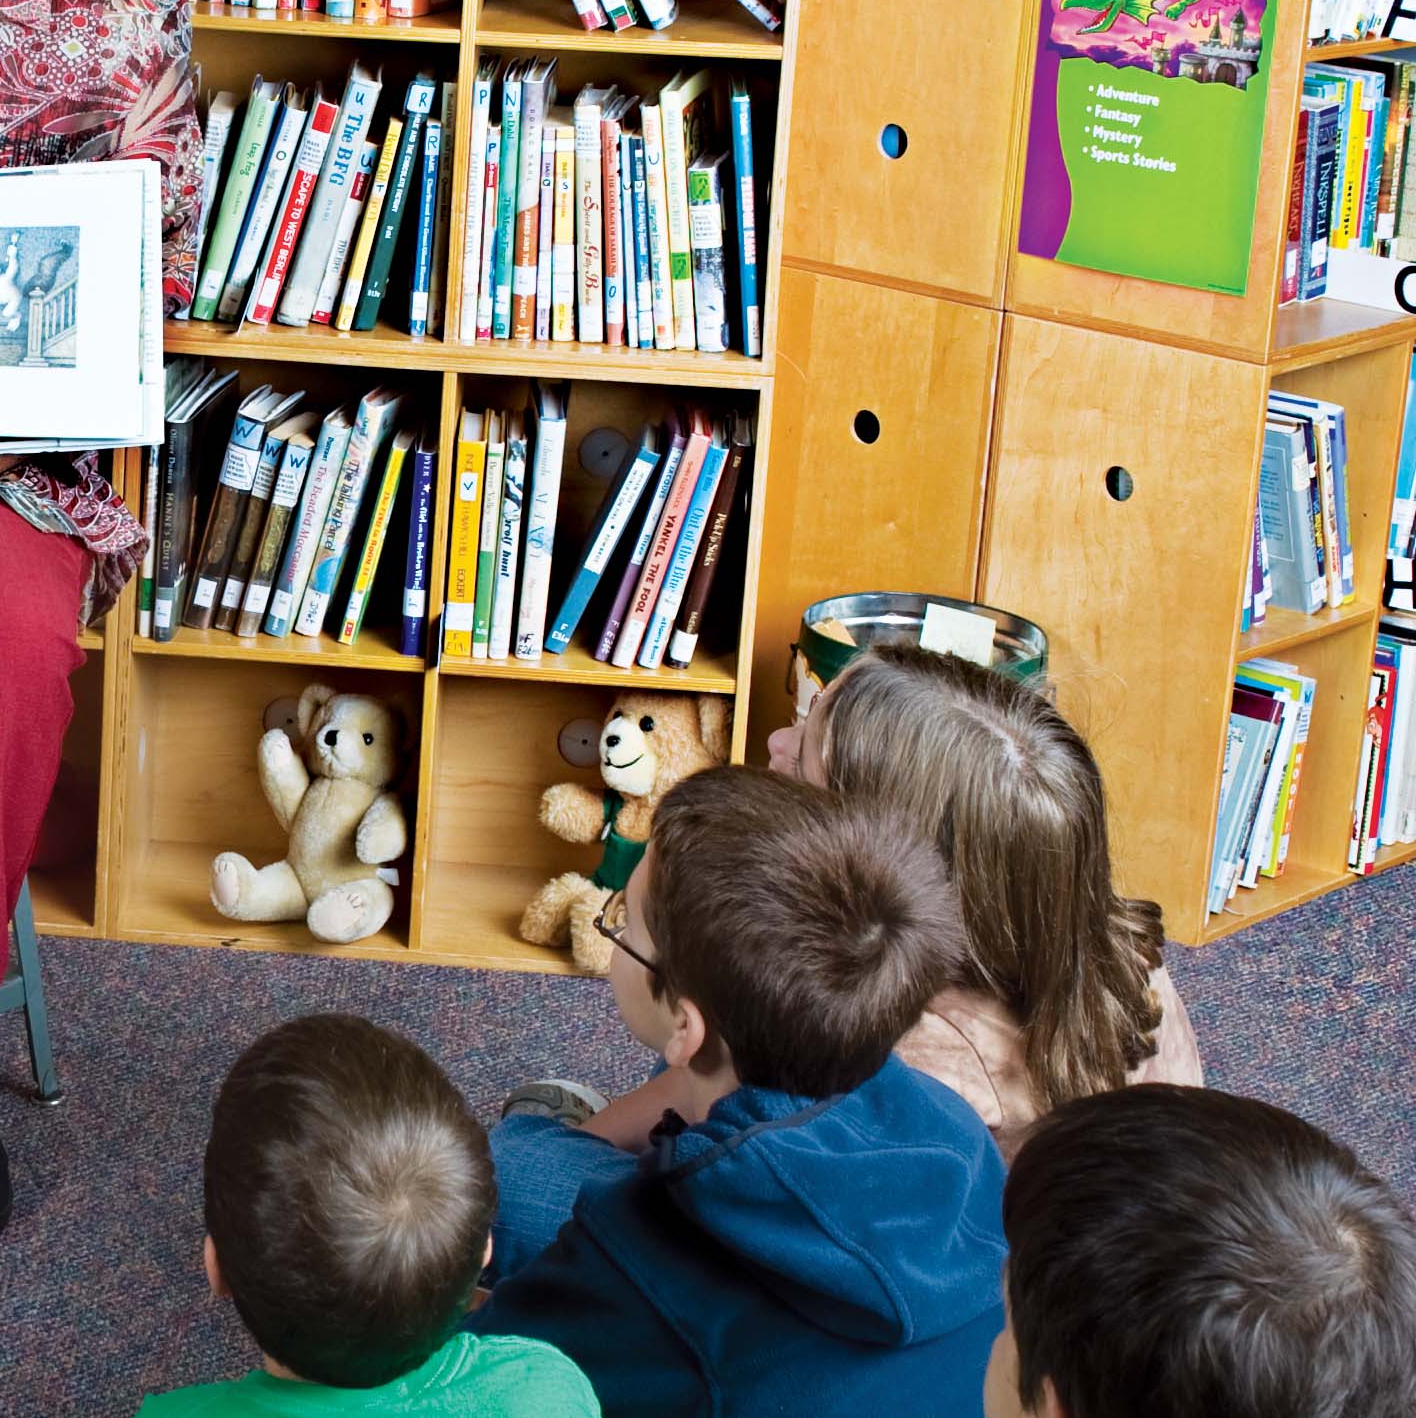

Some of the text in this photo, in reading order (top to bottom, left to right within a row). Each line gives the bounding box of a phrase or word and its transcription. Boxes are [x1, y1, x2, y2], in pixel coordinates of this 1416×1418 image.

[479, 89, 488, 104] P
[505, 92, 517, 107] N
[1096, 84, 1160, 107] Adventure
[1094, 104, 1142, 128] Fantasy
[330, 114, 364, 187] The BFG
[1093, 124, 1143, 149] Mystery
[1090, 145, 1177, 173] Sports Stories
[1288, 161, 1305, 241] INKHEART
[1316, 162, 1333, 240] INKSPELL
[271, 206, 302, 281] TO WEST BERLIN
[523, 232, 531, 248] AND
[235, 423, 257, 439] W
[266, 443, 281, 458] W
[289, 454, 306, 469] W
[306, 465, 328, 527] The Beaded
[324, 460, 360, 551] The Talking Parcel
[161, 535, 172, 572] QUEST
[669, 507, 704, 592] Out of the Blue
[500, 551, 511, 577] hunt
[635, 514, 677, 614] YANKEL THE FOOL
[456, 568, 466, 598] ECKERT
